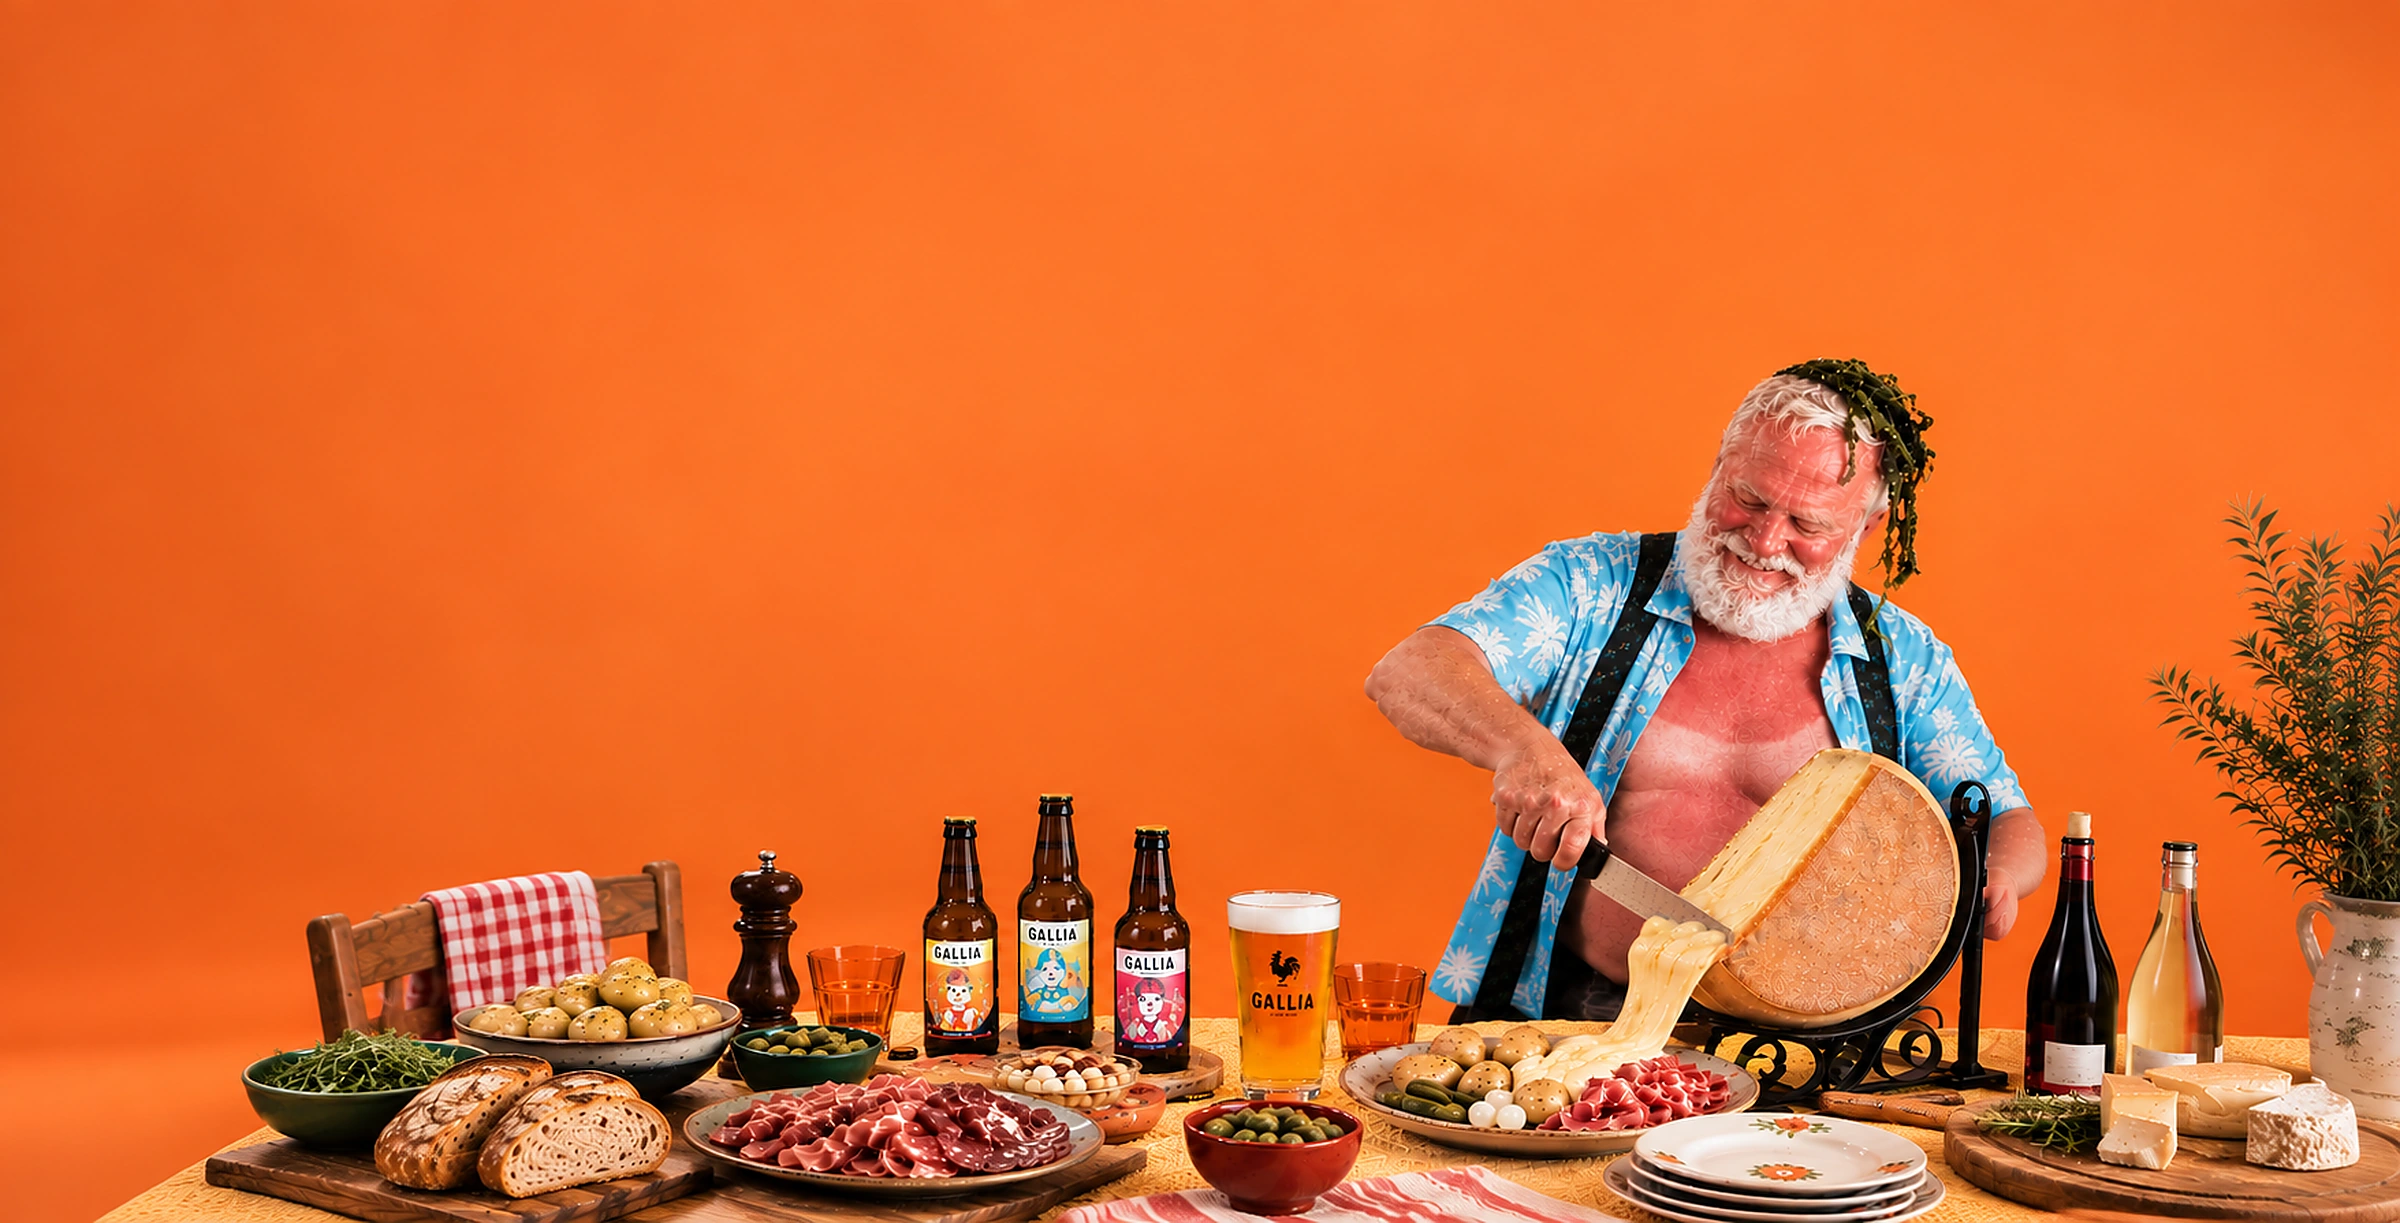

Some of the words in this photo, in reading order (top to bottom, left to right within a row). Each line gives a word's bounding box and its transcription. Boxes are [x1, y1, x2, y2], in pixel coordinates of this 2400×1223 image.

[1028, 927, 1077, 941] GALLIA
[934, 946, 981, 960] GALLIA
[1124, 955, 1174, 971] GALLIA
[1252, 992, 1314, 1010] GALLIA
